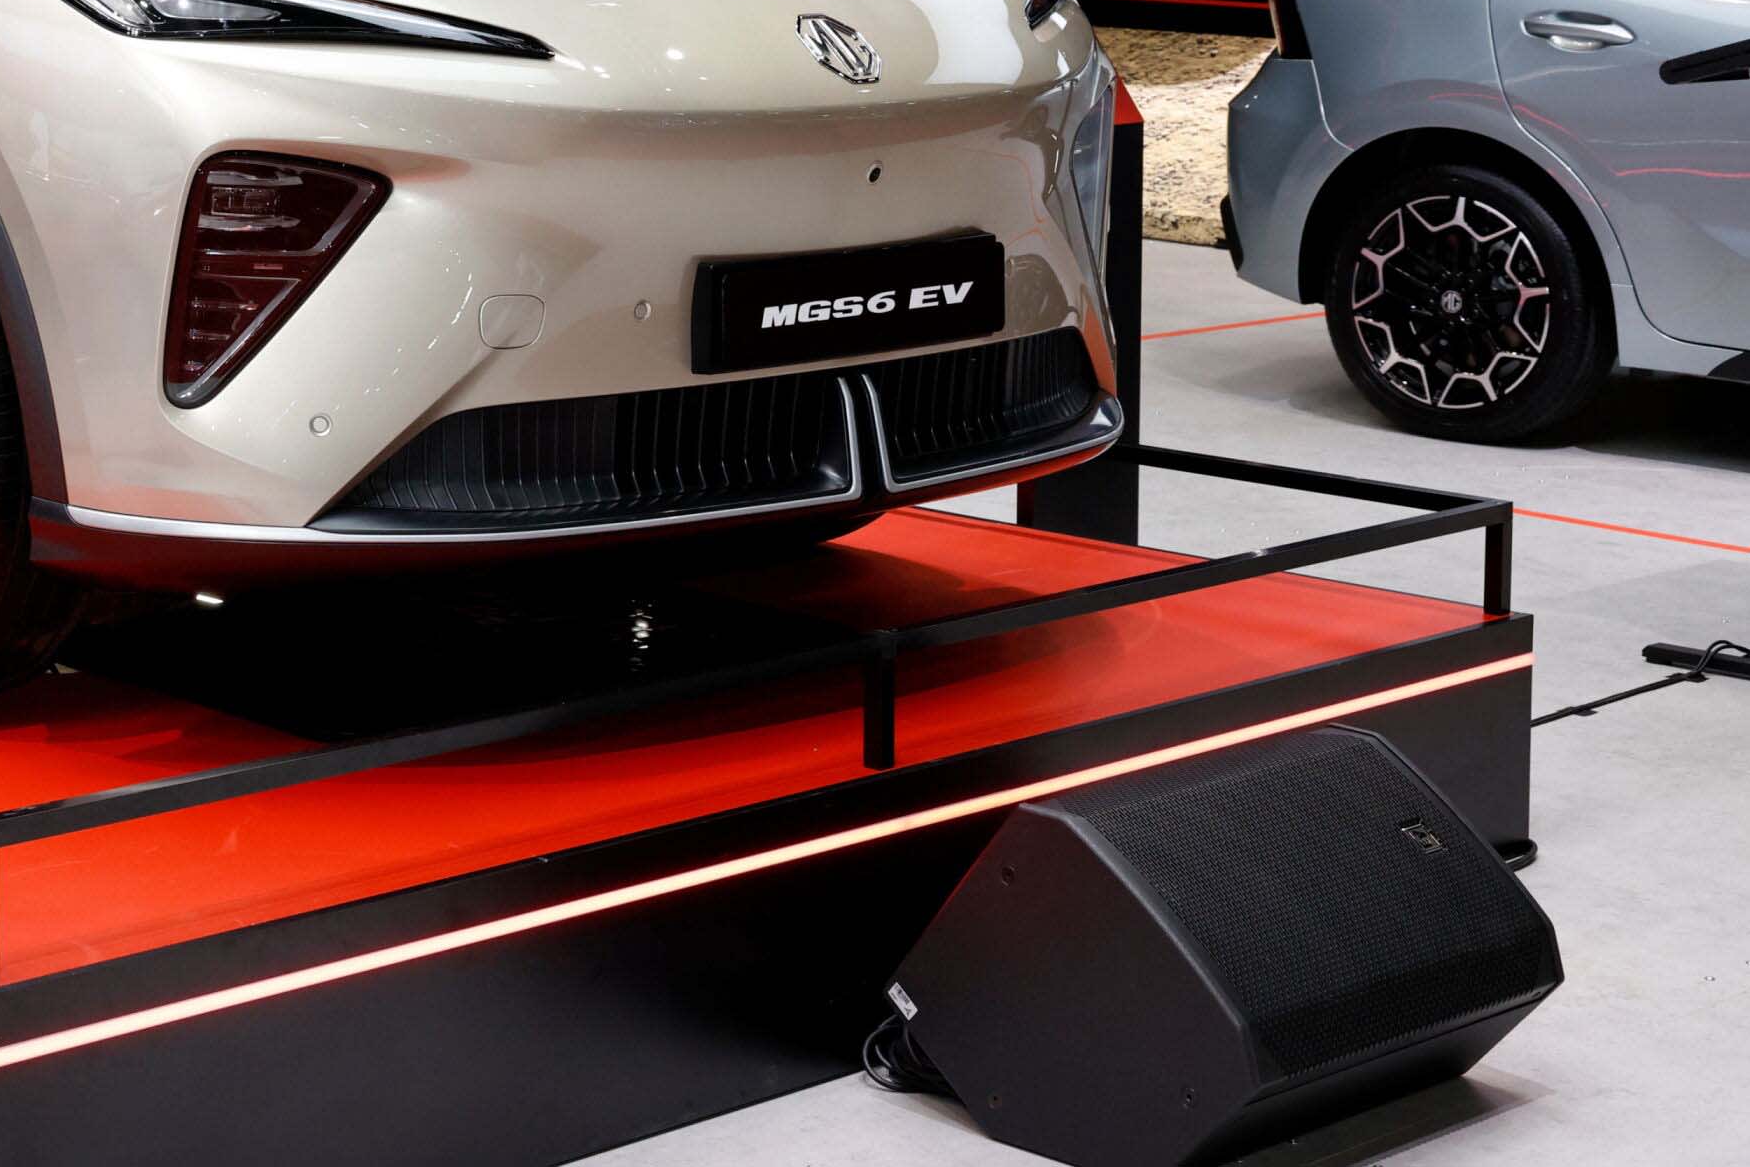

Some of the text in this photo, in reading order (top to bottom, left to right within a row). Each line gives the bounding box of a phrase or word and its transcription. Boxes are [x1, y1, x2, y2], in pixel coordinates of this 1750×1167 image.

[800, 17, 877, 80] MG
[761, 281, 974, 329] MGS6 EV
